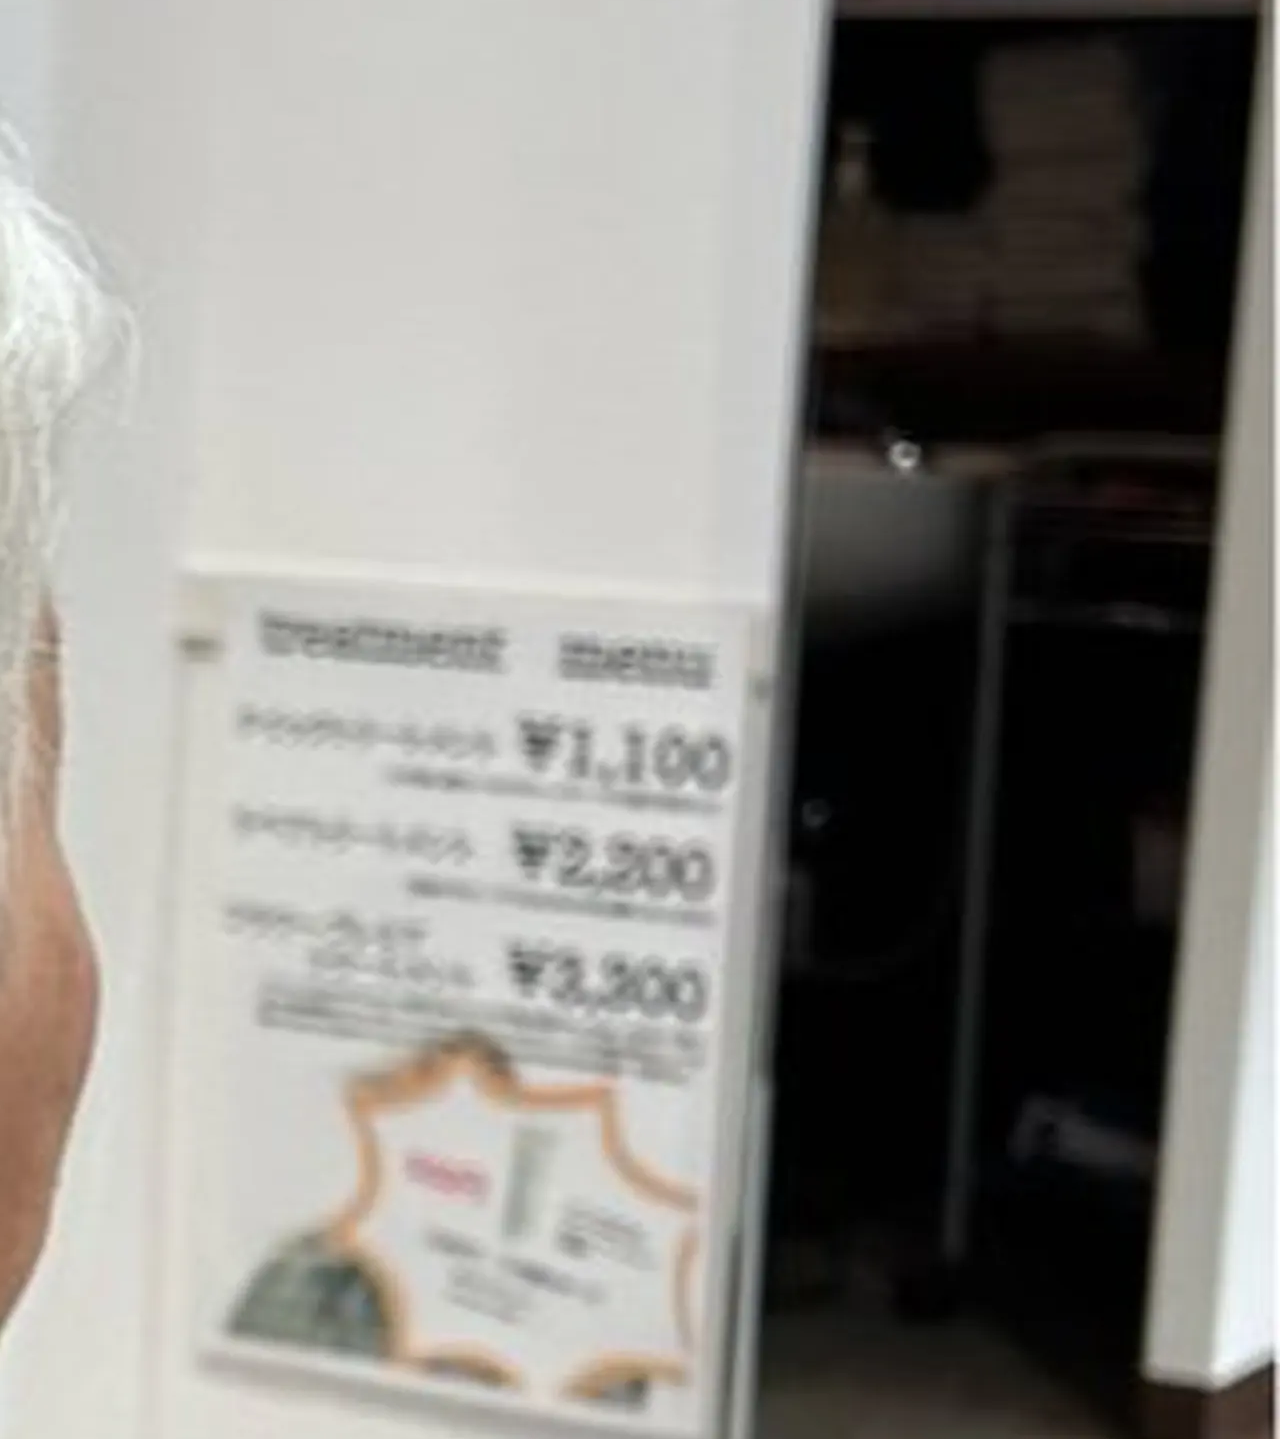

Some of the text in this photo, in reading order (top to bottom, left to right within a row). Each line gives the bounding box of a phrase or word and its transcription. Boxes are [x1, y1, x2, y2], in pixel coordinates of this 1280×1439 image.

[261, 609, 714, 691] treatment menu
[517, 714, 732, 790] ¥1,100
[512, 825, 714, 901] ¥2,200
